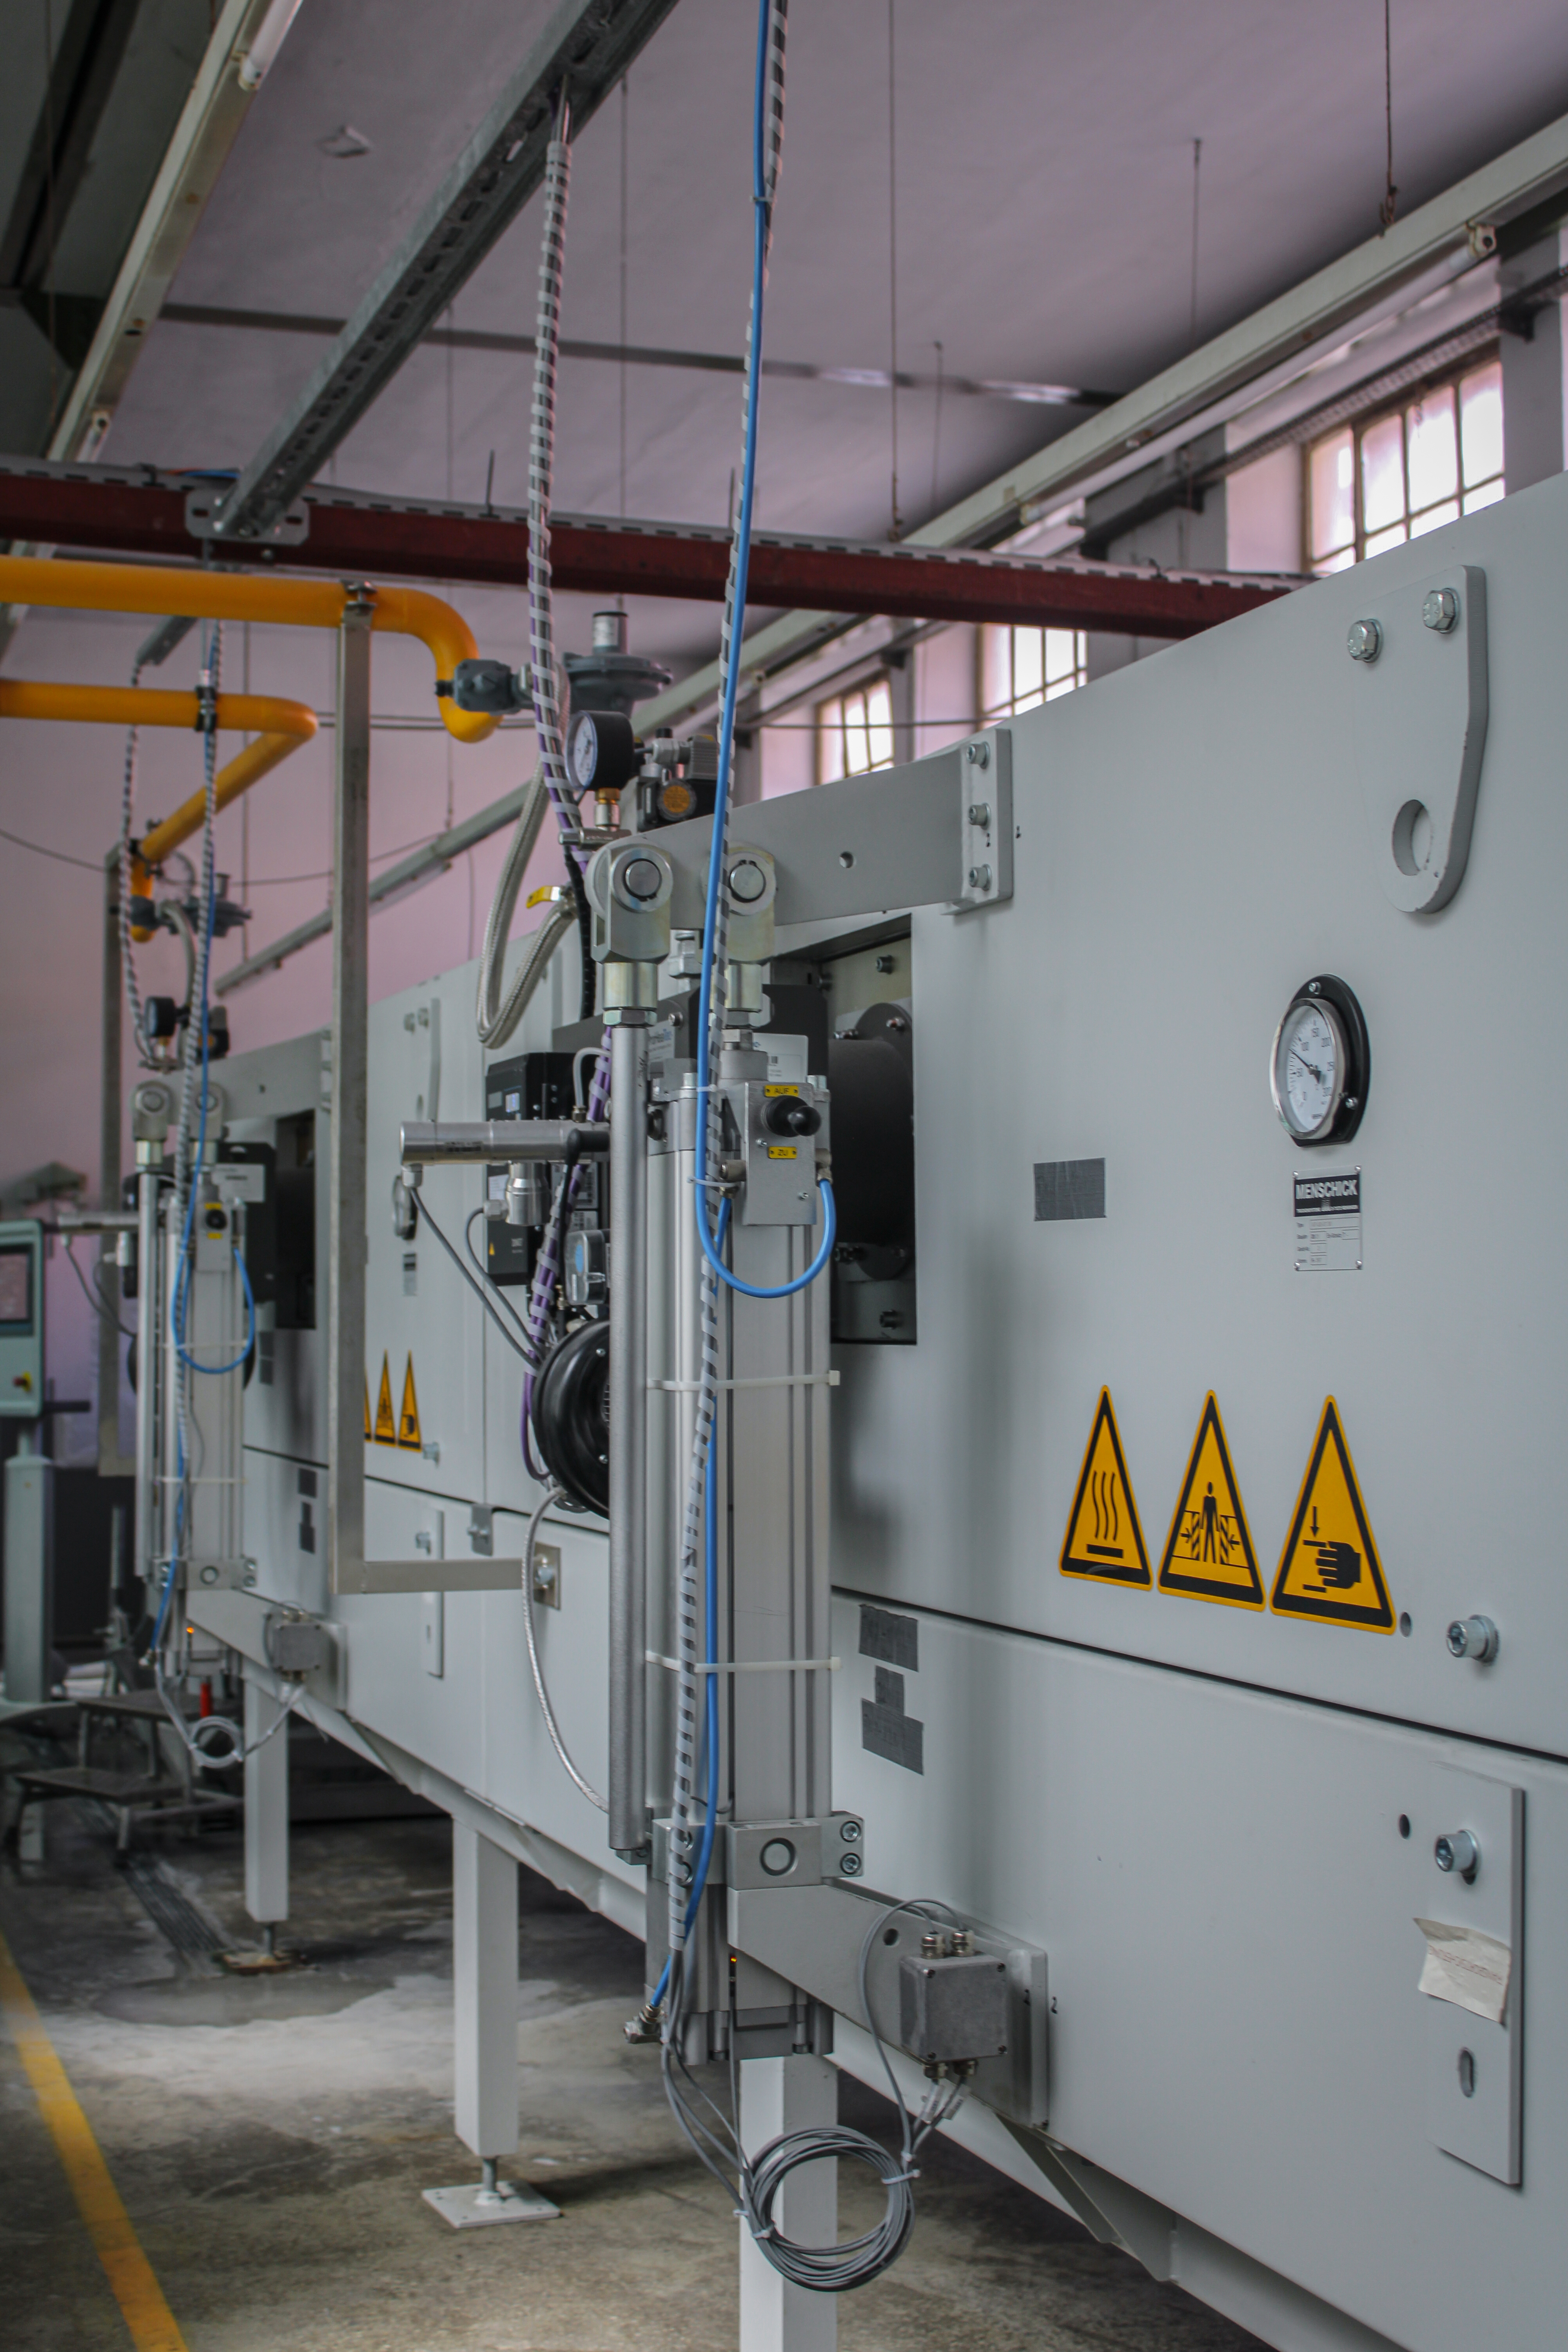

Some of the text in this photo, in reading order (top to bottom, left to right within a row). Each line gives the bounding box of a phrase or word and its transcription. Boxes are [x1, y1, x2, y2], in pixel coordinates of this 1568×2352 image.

[1321, 1036, 1330, 1047] 200
[1296, 1067, 1303, 1077] 50
[1302, 1091, 1306, 1101] 0
[1322, 1087, 1332, 1097] 300
[1296, 1180, 1358, 1199] MENSCHICK
